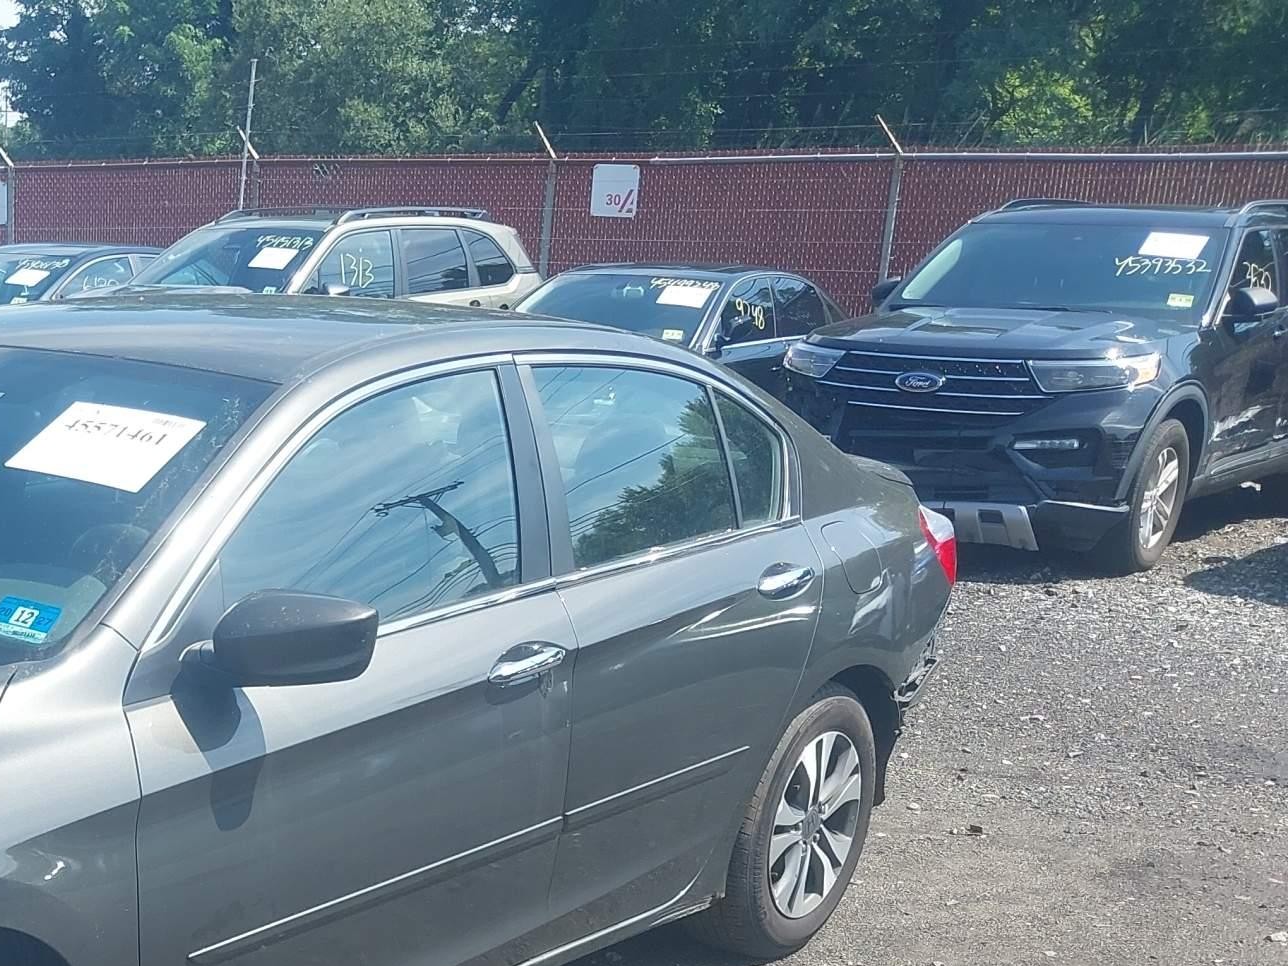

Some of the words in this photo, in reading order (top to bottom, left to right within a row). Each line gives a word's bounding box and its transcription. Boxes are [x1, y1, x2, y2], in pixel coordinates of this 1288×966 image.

[1115, 255, 1212, 277] 45393532
[64, 418, 169, 446] 45571461
[13, 608, 36, 625] 12
[36, 616, 53, 627] 27
